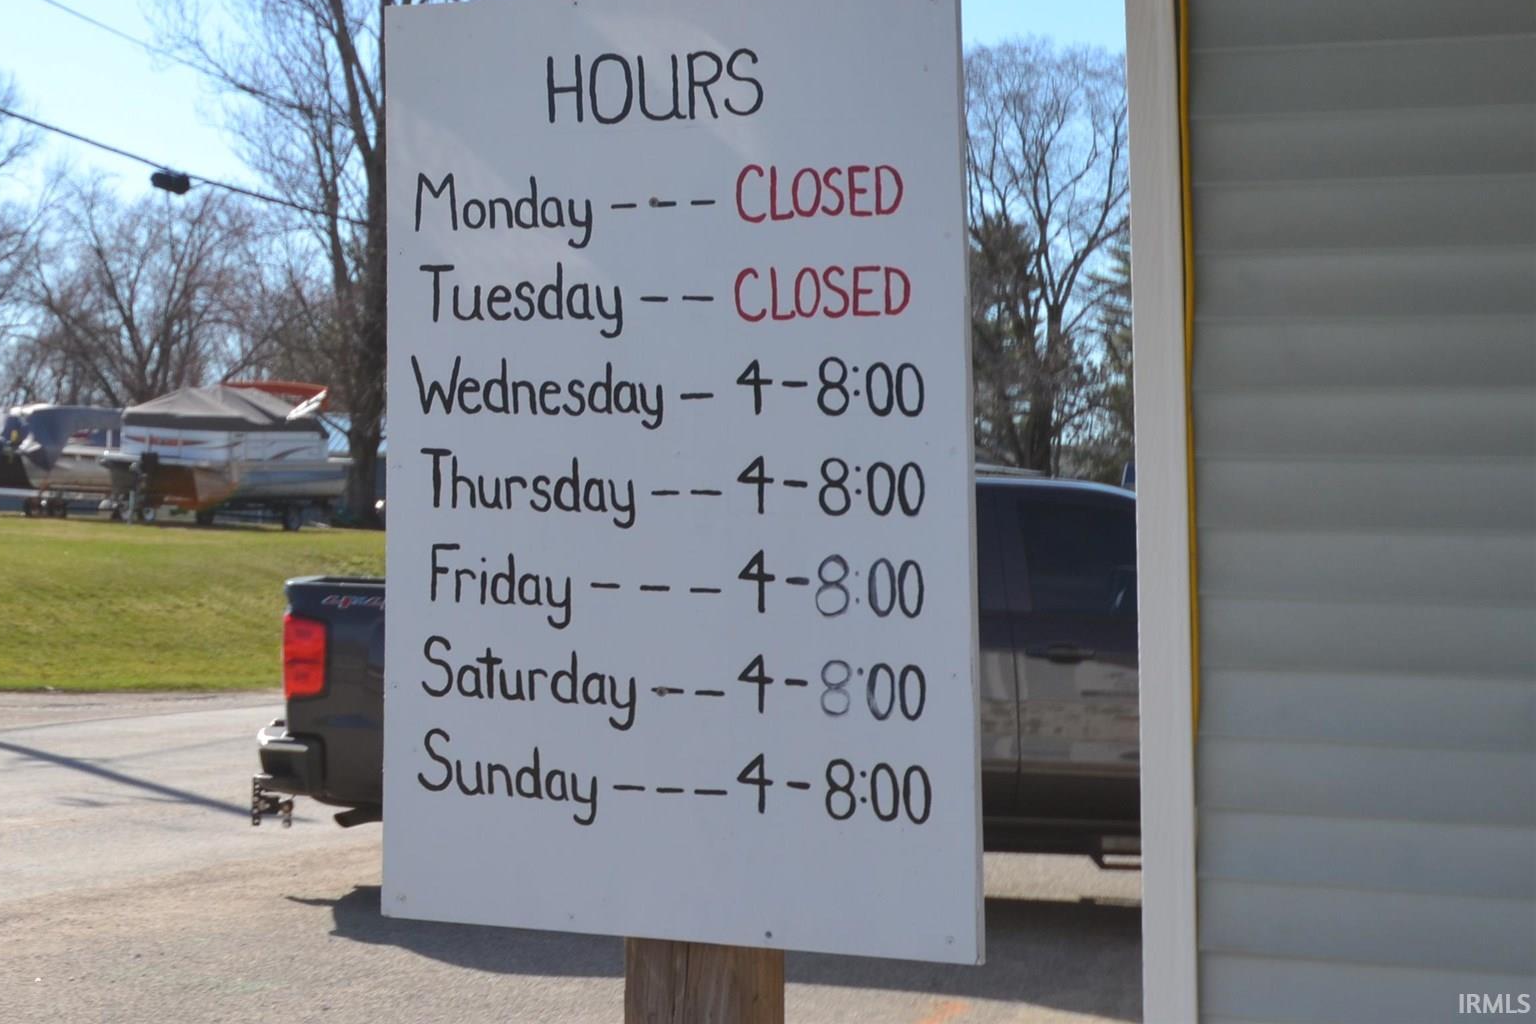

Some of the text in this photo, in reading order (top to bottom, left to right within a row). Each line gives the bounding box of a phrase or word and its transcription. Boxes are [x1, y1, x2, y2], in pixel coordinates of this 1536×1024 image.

[546, 47, 765, 125] HOURS
[414, 172, 593, 249] Monday
[735, 164, 904, 224] CLOSED
[419, 261, 624, 339] Tuesday
[734, 266, 911, 323] CLOSED
[410, 355, 664, 431] Wednesday
[420, 447, 636, 530] Thursday
[430, 543, 572, 630] Friday
[421, 635, 637, 732] Saturday
[417, 727, 598, 826] Sunday
